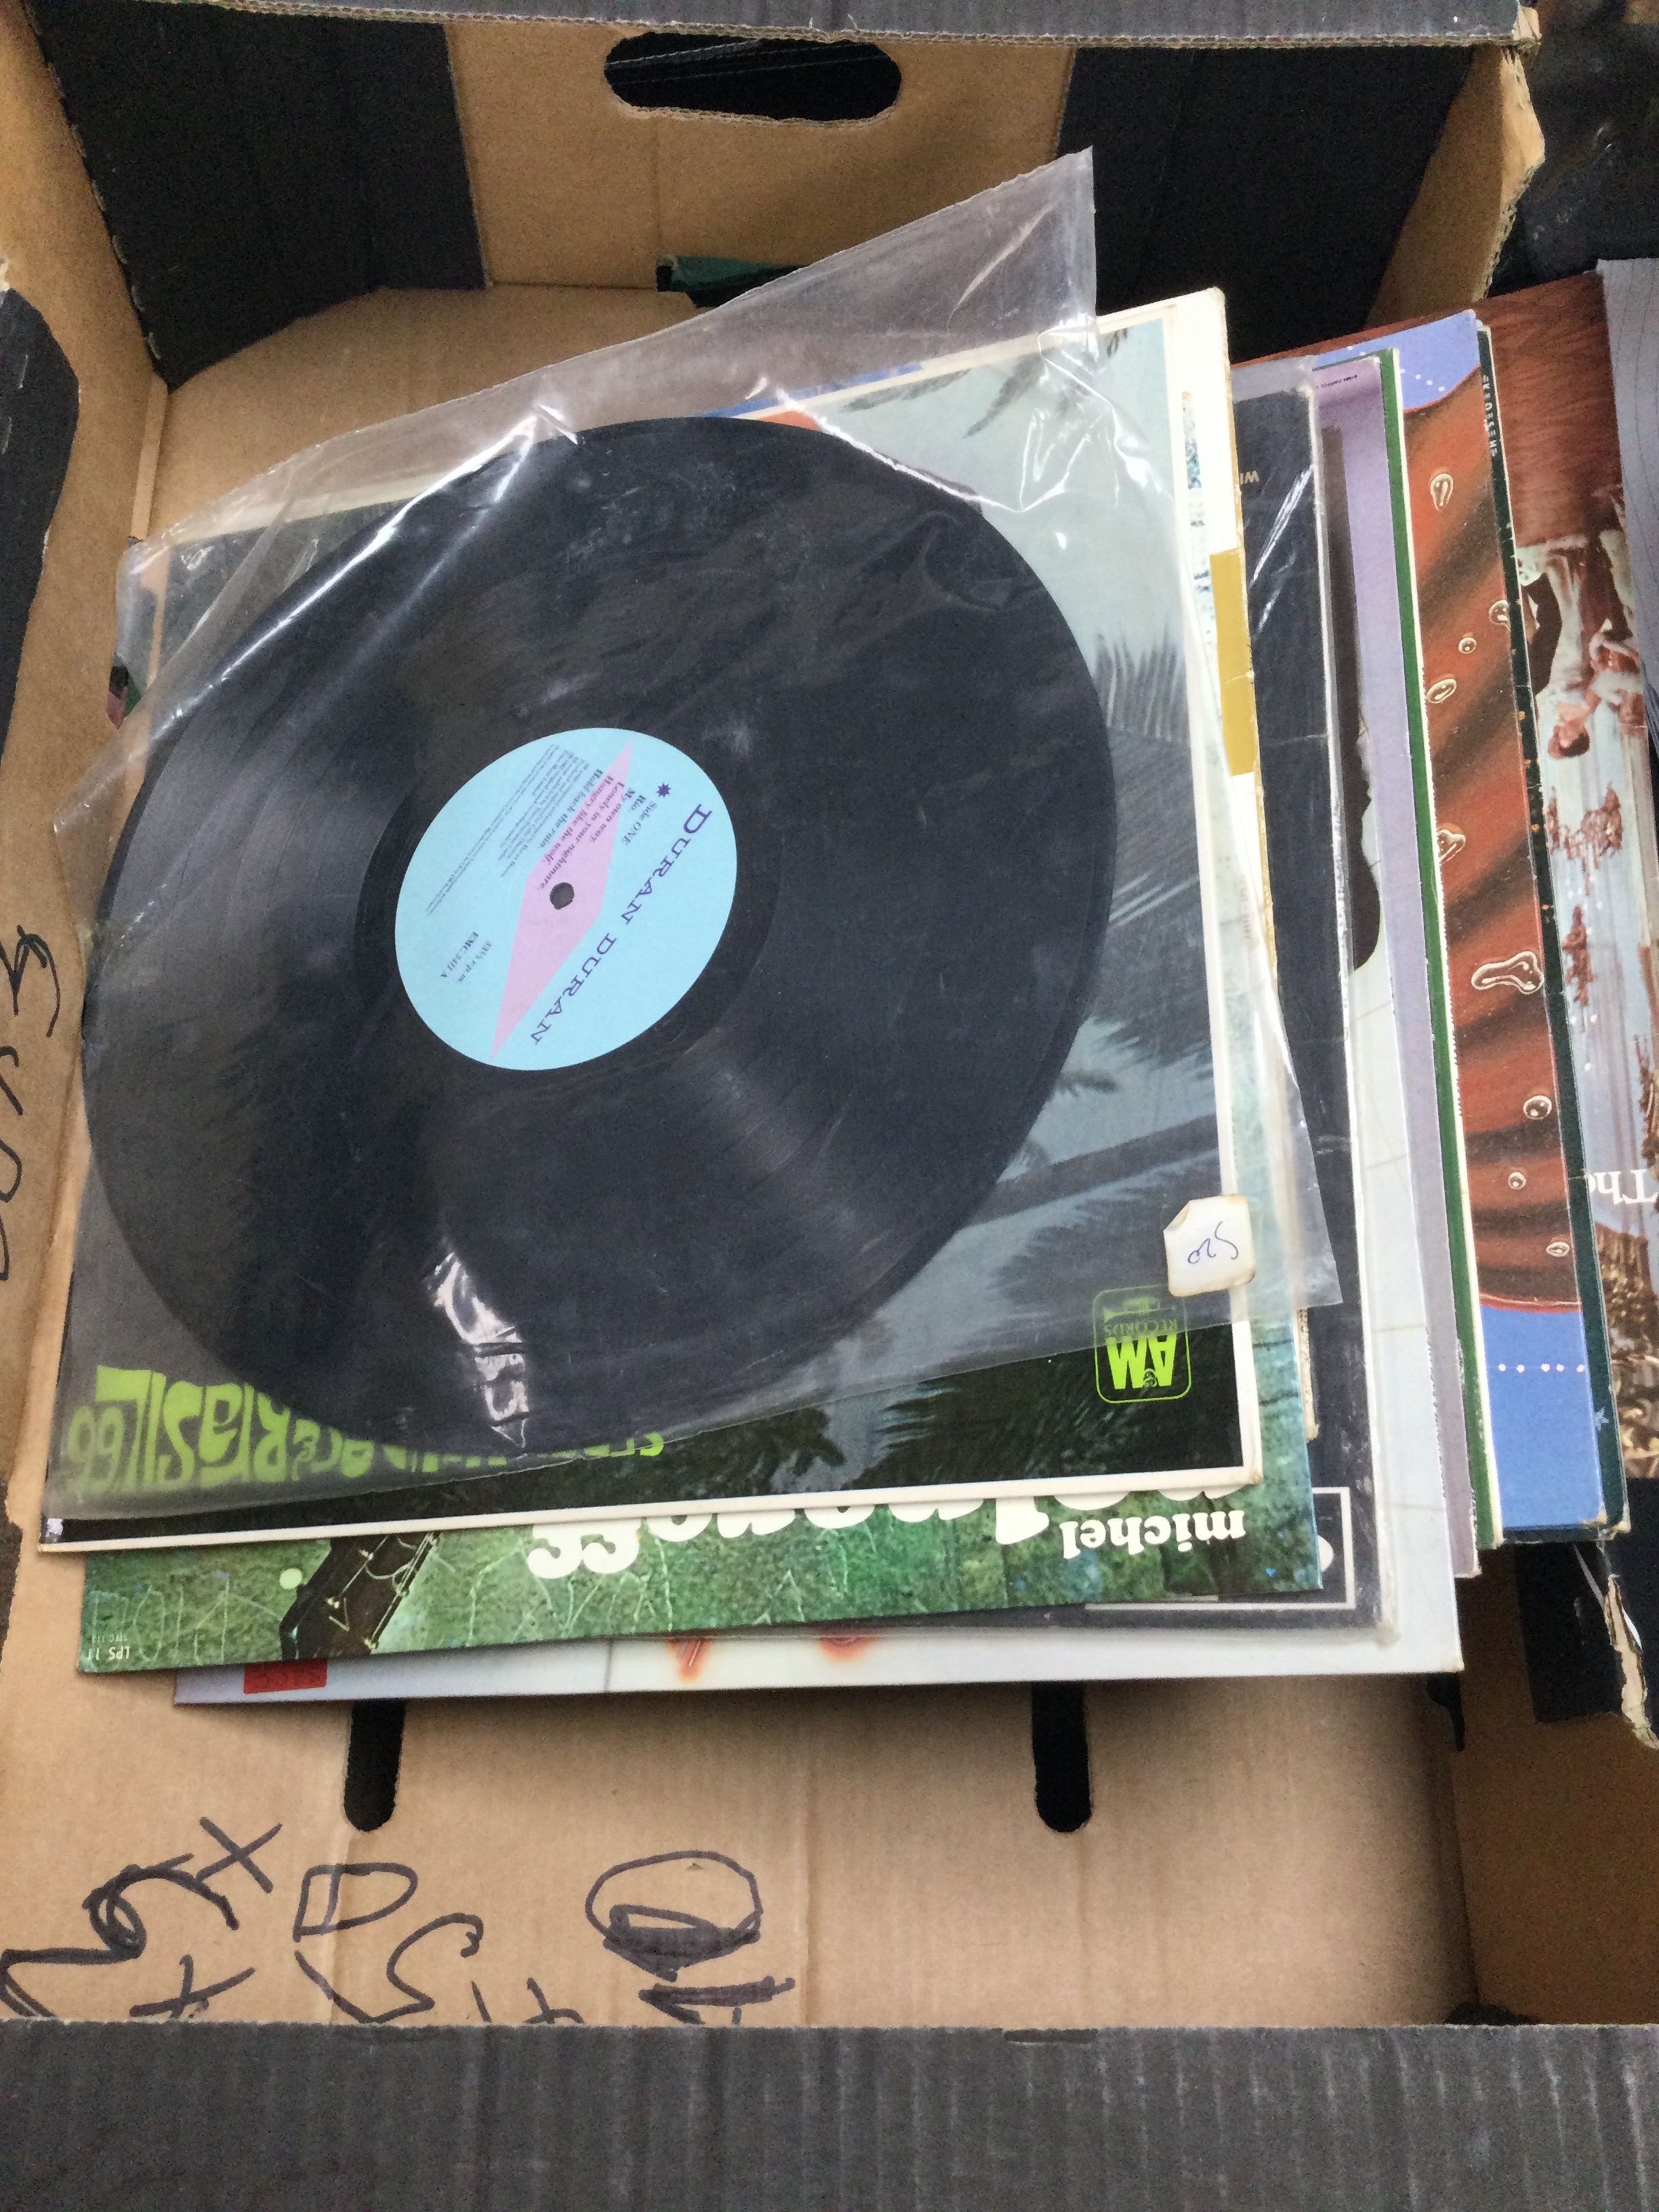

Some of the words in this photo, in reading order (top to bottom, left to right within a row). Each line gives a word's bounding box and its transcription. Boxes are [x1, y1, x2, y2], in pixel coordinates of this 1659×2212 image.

[583, 769, 603, 792] Hold
[566, 790, 586, 813] back
[584, 775, 614, 809] Hungry
[598, 781, 625, 811] Lonely
[620, 787, 636, 802] My
[554, 813, 569, 828] the
[571, 809, 588, 827] like
[590, 811, 600, 821] in
[605, 802, 621, 822] own
[638, 801, 657, 821] Side
[560, 827, 574, 842] the
[573, 821, 592, 843] your
[621, 821, 642, 846] ONE
[617, 802, 713, 924] DURAN
[459, 931, 478, 951] EMC
[529, 933, 617, 1044] DURAN
[1061, 1509, 1246, 1559] michel
[108, 1645, 130, 1661] LPS
